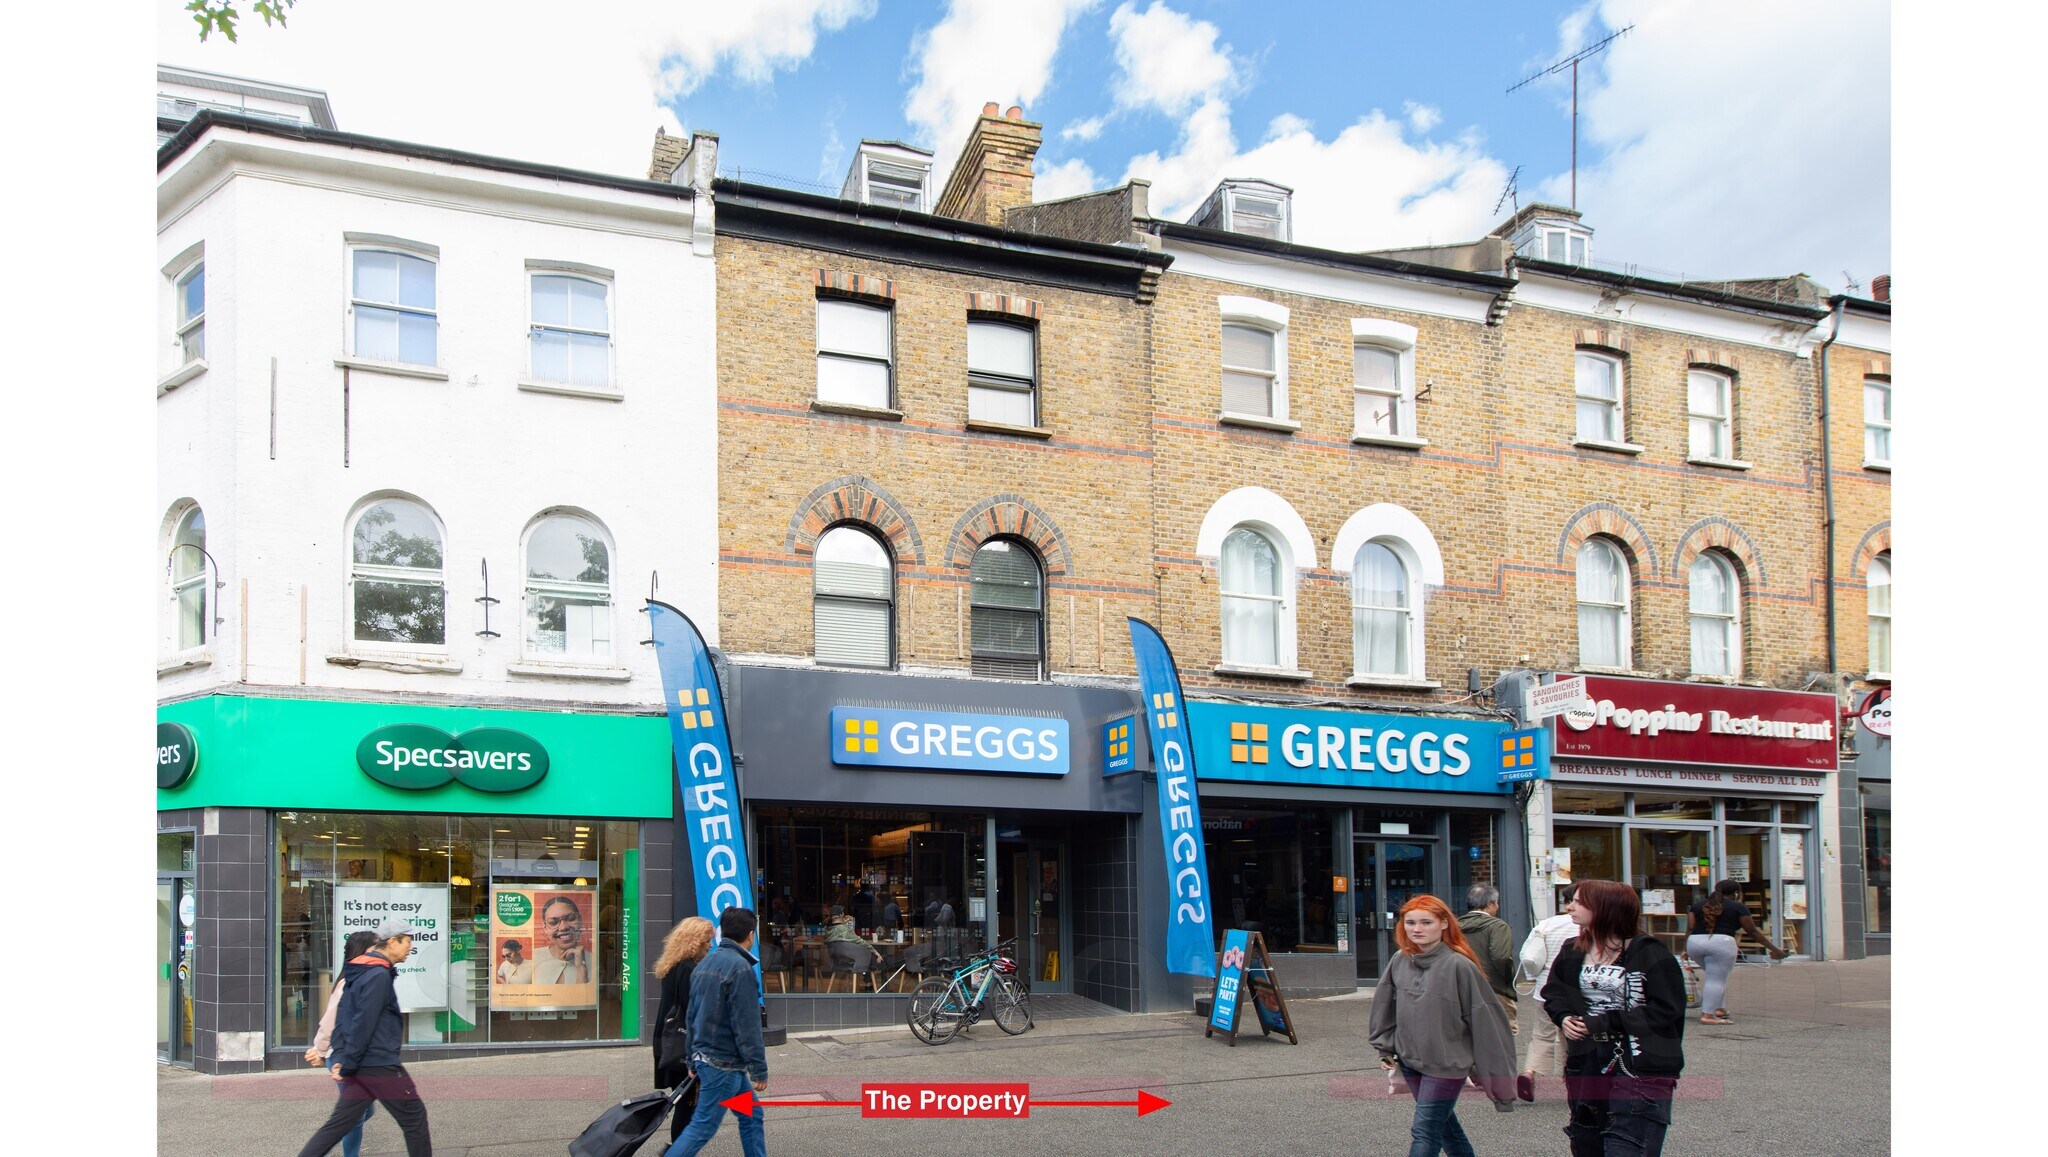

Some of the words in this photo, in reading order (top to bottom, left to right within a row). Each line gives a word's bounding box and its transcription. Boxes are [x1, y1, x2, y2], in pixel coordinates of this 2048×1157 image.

[1533, 680, 1580, 698] SANDWICHES
[1541, 689, 1580, 705] SAVOURIES
[1596, 699, 1703, 736] Poppins
[1709, 710, 1833, 741] Restaurant
[890, 721, 1059, 762] GREGGS
[1281, 723, 1471, 776] GREGGS
[375, 740, 531, 772] Specsavers
[1110, 758, 1128, 768] GREGGS
[1508, 772, 1533, 780] GREGGS
[1558, 764, 1628, 777] BREAKFAST
[1635, 768, 1673, 779] LUNCH
[1679, 770, 1722, 782] DINNER
[1732, 773, 1775, 785] SERVED
[1778, 776, 1798, 786] ALL
[1800, 777, 1821, 787] DAY
[505, 894, 516, 902] for
[365, 901, 388, 911] not
[390, 904, 422, 914] easy
[344, 915, 380, 929] being
[383, 915, 436, 929] ring
[622, 908, 630, 960] Hearing
[622, 962, 630, 992] Aids
[1218, 989, 1237, 1002] PARTY
